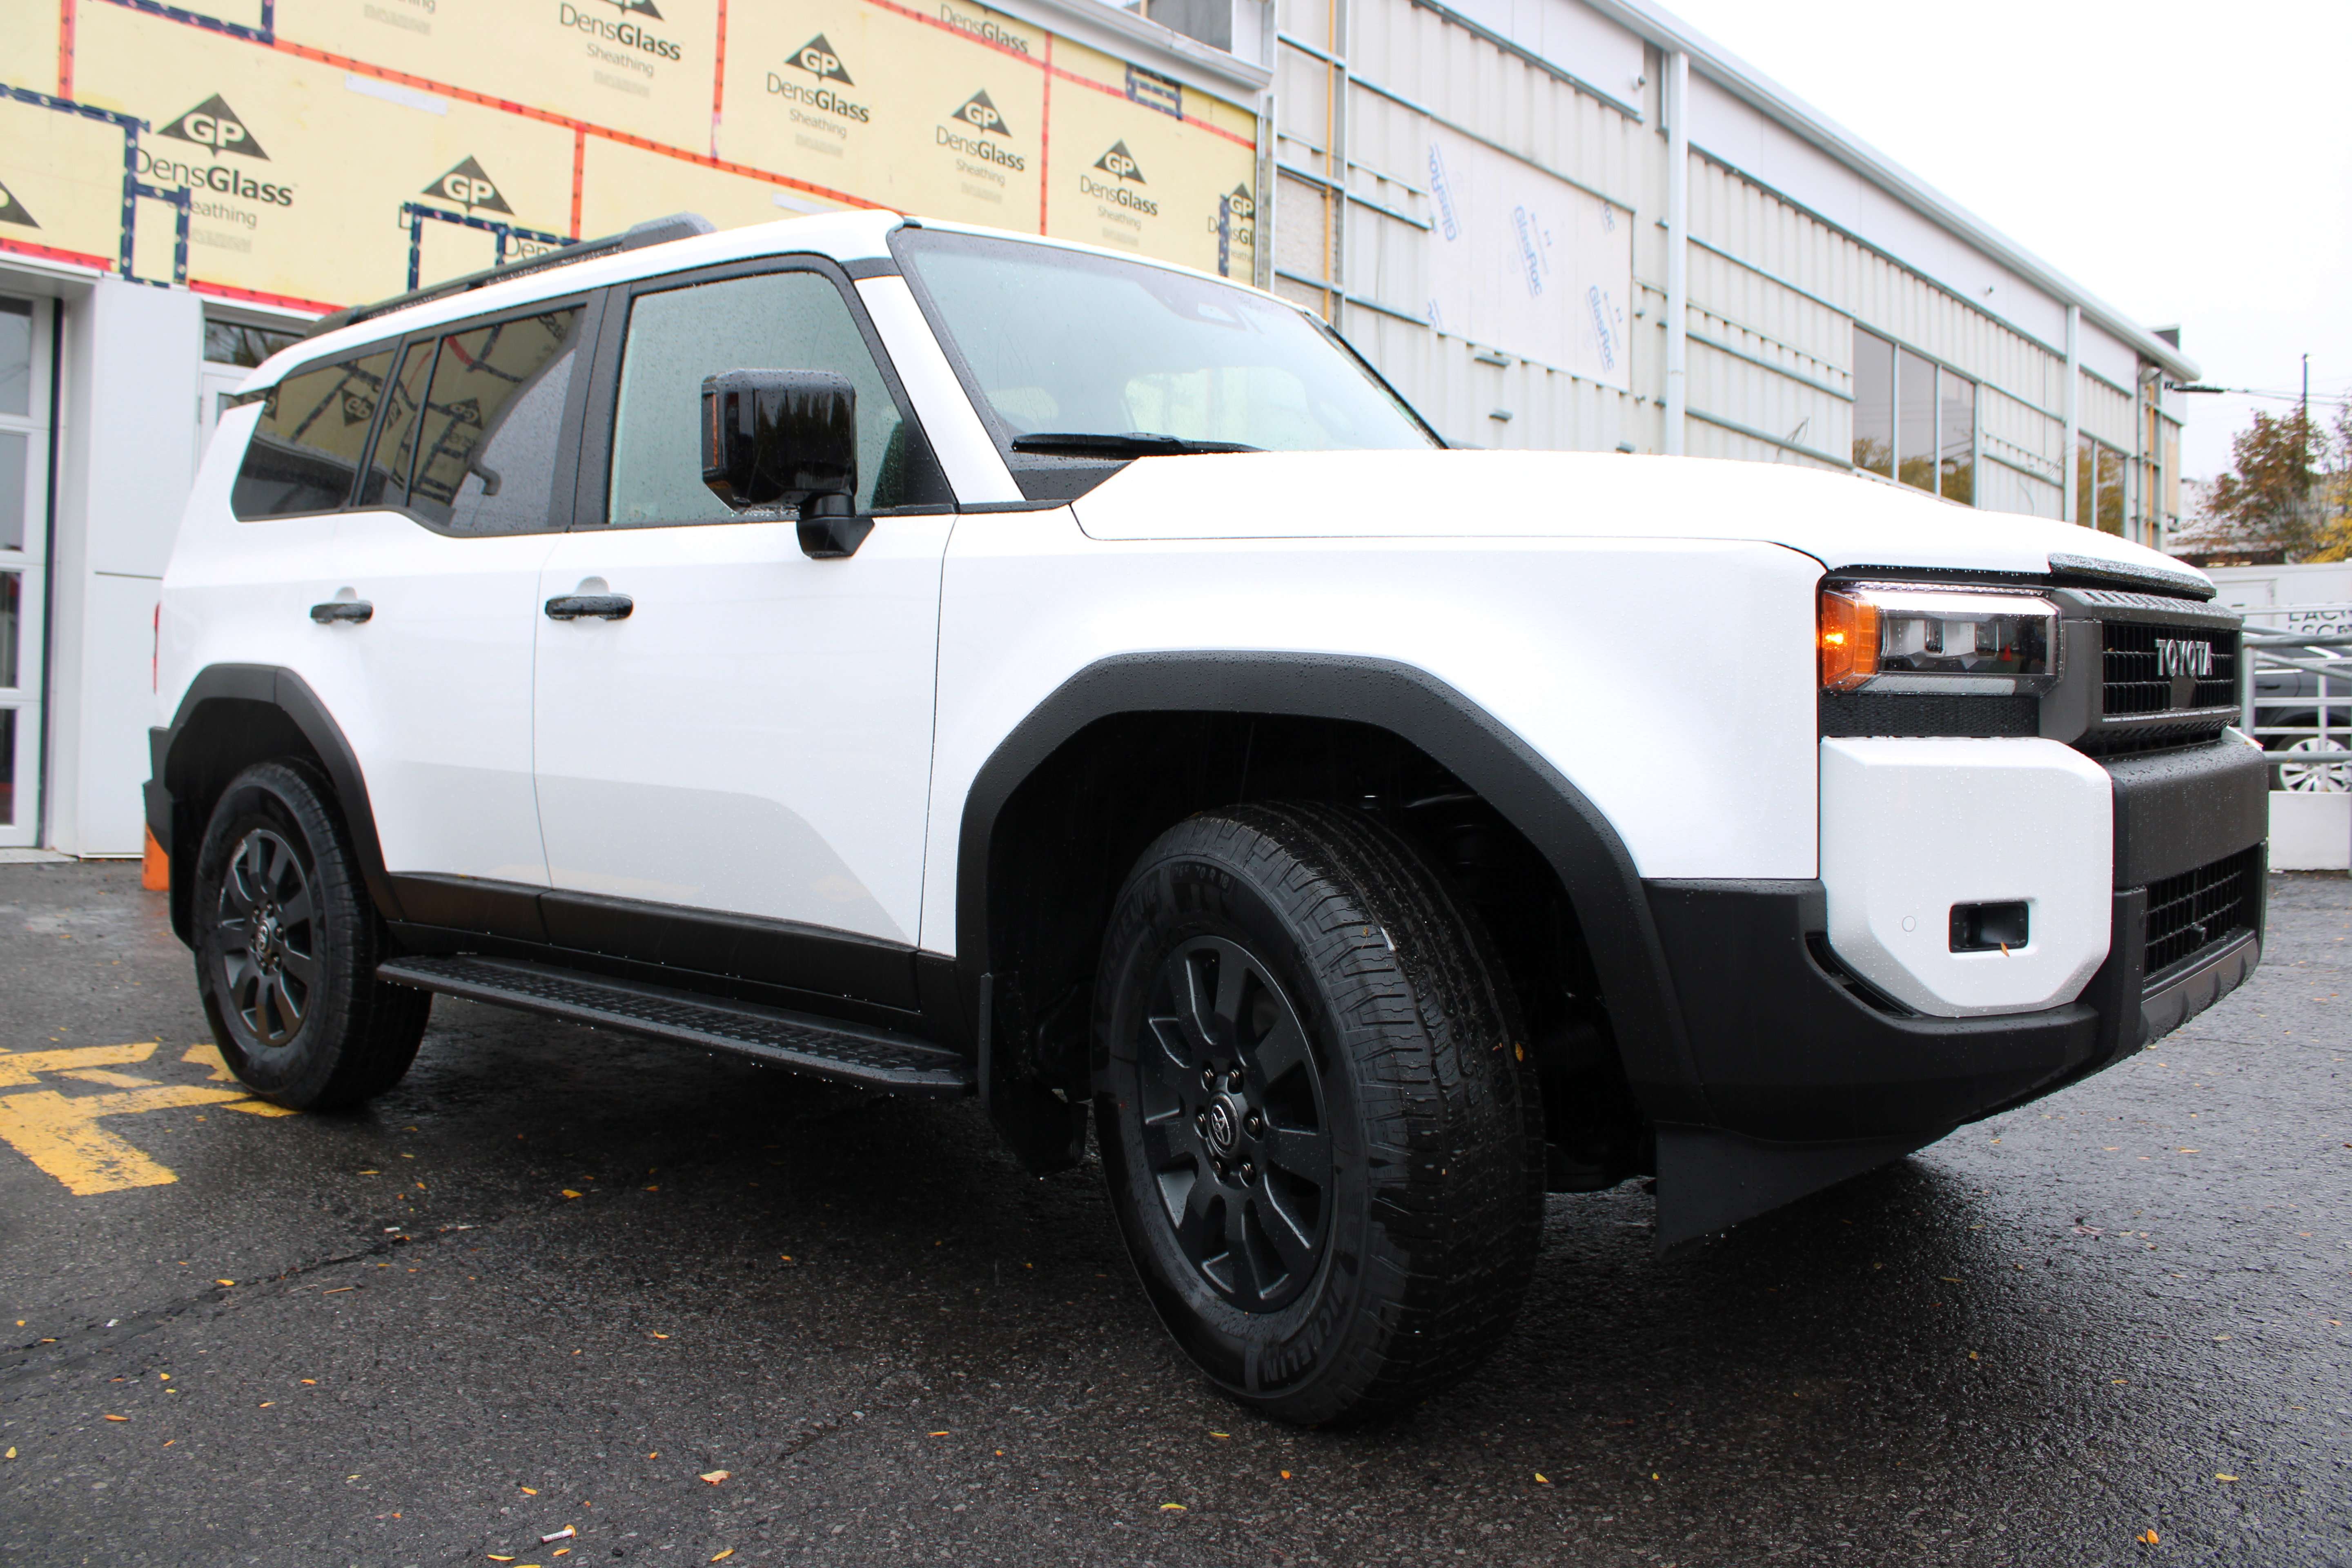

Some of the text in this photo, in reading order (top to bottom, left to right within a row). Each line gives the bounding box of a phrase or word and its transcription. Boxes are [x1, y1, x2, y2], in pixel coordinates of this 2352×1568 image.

[560, 2, 681, 61] DensGlass
[940, 3, 1028, 53] DensGlass
[587, 42, 654, 79] Sheathing
[800, 47, 840, 75] GP
[766, 71, 869, 123] DensGlass
[964, 100, 999, 128] GP
[184, 112, 245, 148] GP
[789, 107, 847, 138] Sheathing
[936, 124, 1025, 172] DensGlass
[1105, 151, 1135, 176] GP
[137, 148, 293, 207] DensGlass
[443, 173, 494, 204] GP
[956, 158, 1005, 187] Sheathing
[1080, 174, 1158, 216] DensGlass
[1229, 194, 1255, 217] GP
[167, 199, 257, 230] eathing
[1098, 205, 1142, 231] Sheathing
[1514, 205, 1542, 296] GlasRoc
[1589, 285, 1615, 370] GlasRoc
[2155, 639, 2213, 677] TOYOTA
